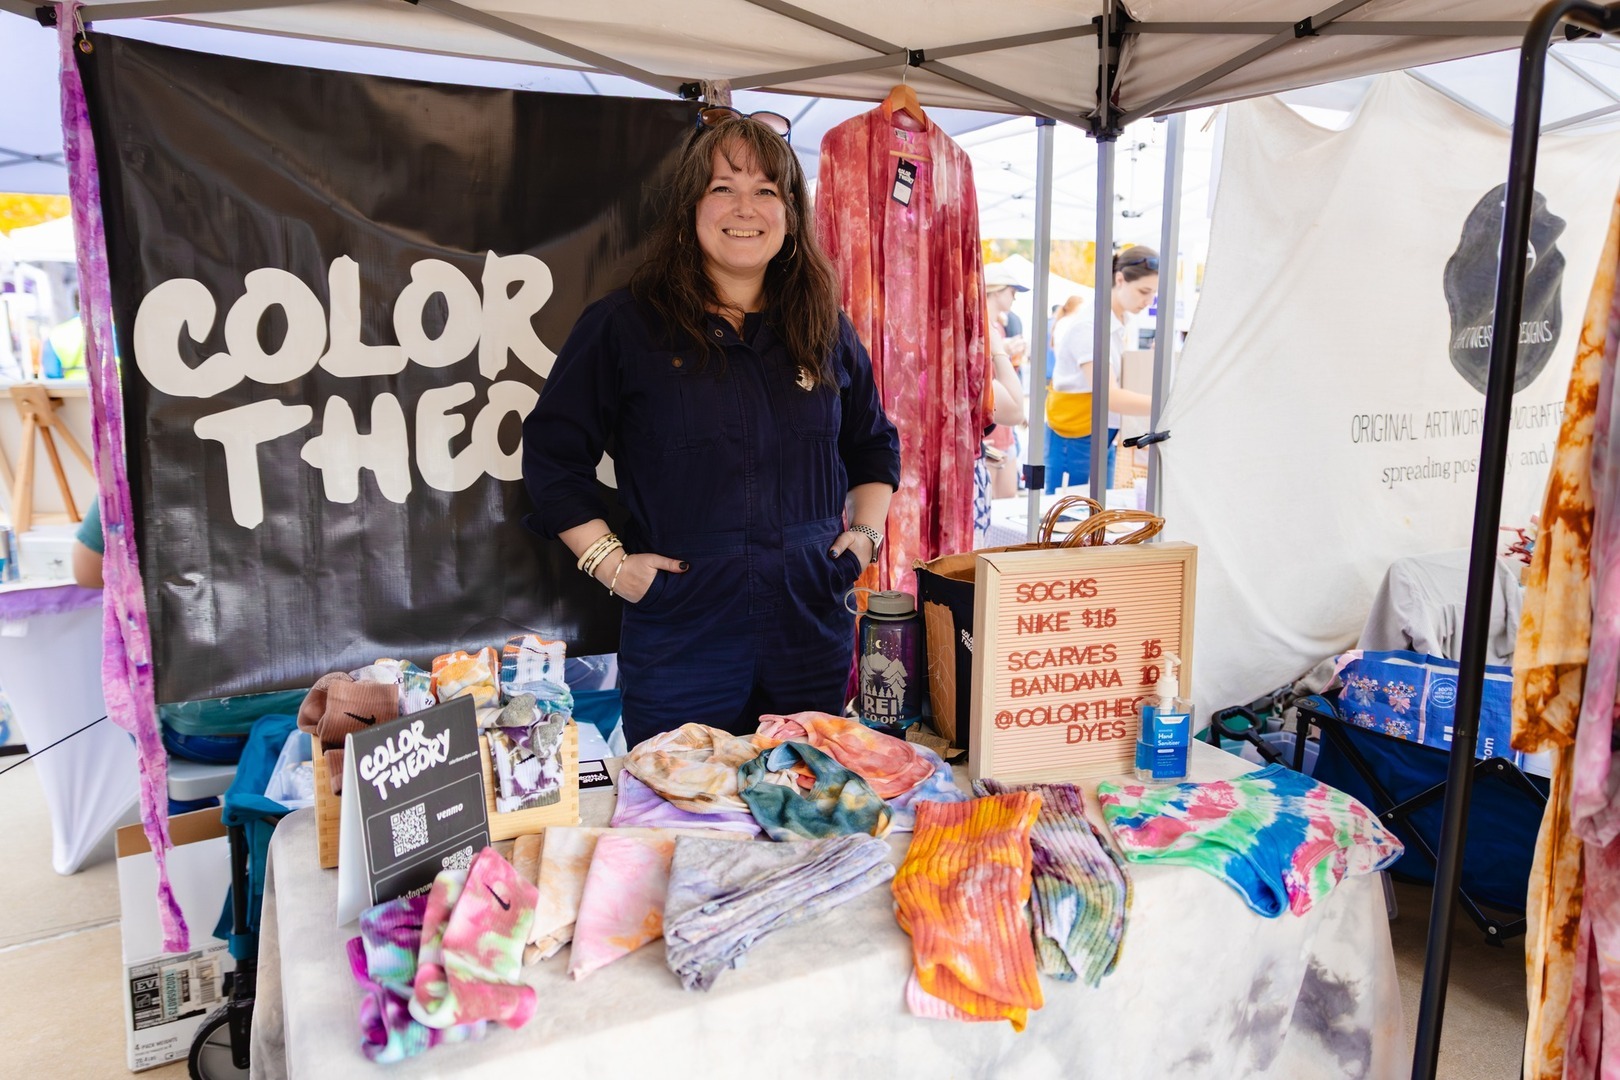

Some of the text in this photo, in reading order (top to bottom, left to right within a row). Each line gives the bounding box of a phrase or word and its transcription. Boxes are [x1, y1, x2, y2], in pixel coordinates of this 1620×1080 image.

[134, 250, 557, 398] COLOR
[1519, 320, 1553, 344] ESIGNS
[1351, 413, 1418, 443] ORIGINAL
[193, 381, 541, 529] THEO
[1382, 456, 1451, 489] spreading
[1521, 443, 1549, 466] and
[1016, 578, 1098, 603] SOCKS
[1017, 607, 1117, 635] NIKE $15
[1008, 639, 1162, 671] SCARVES 15
[1010, 665, 1160, 698] BANDANA 10
[863, 694, 897, 715] REI
[1066, 720, 1126, 744] DYES
[360, 719, 431, 780] COLOR
[1484, 737, 1494, 760] om
[372, 728, 450, 800] THEORY
[436, 803, 464, 821] venmo
[398, 882, 433, 900] stagram
